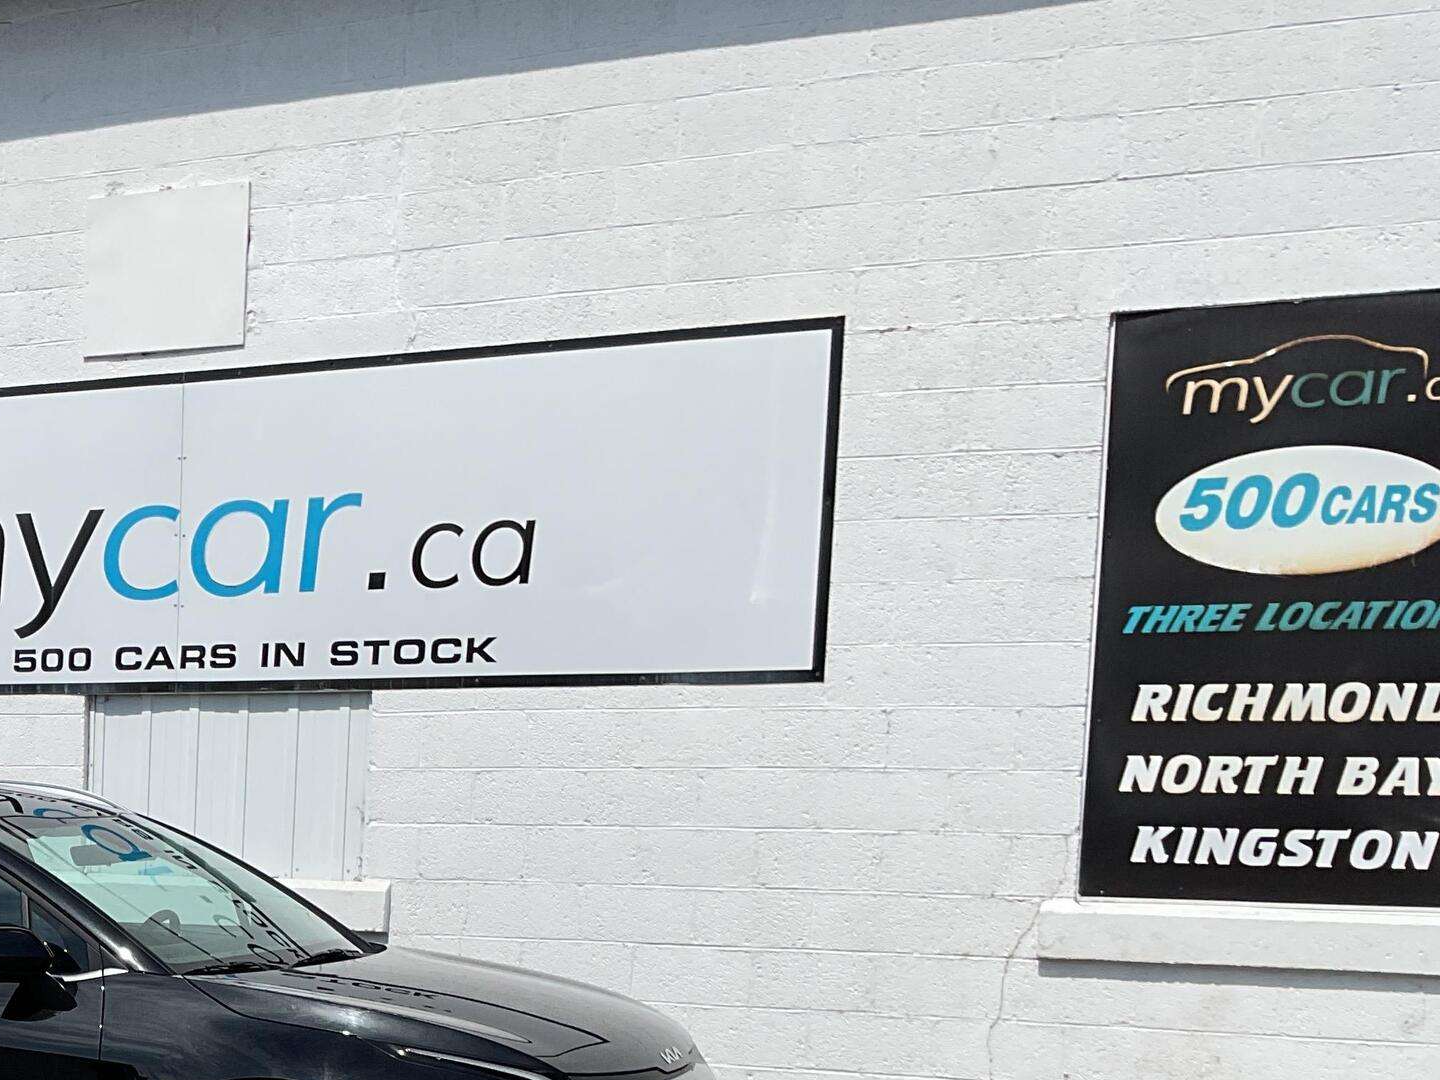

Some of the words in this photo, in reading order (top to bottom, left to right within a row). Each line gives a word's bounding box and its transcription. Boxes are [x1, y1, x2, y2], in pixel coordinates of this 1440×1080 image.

[1182, 368, 1440, 424] mycar.c
[1179, 472, 1321, 532] 500
[1320, 482, 1440, 526] CARS
[1122, 602, 1251, 634] THREE
[13, 647, 92, 673] 500
[114, 643, 237, 671] CARS
[260, 642, 306, 668] IN
[330, 636, 497, 667] STOCK
[1118, 754, 1325, 795] NORTH
[1129, 825, 1440, 871] KINGSTON
